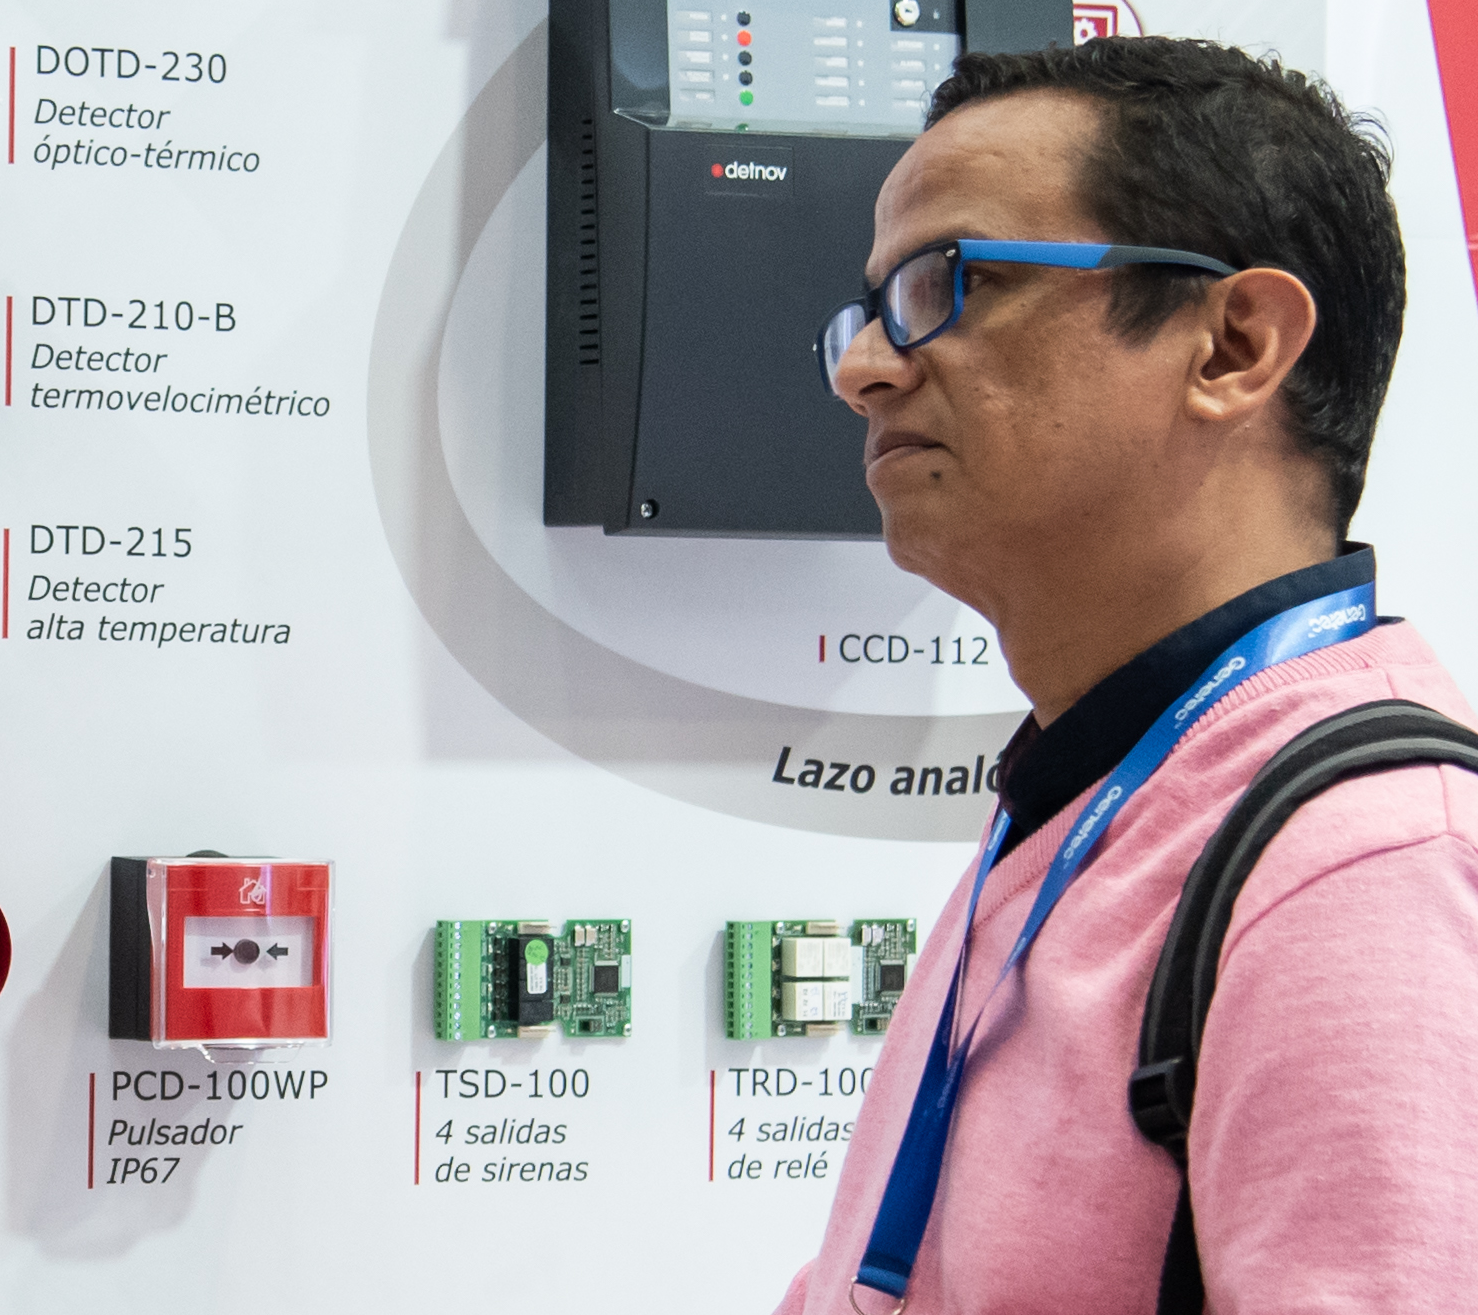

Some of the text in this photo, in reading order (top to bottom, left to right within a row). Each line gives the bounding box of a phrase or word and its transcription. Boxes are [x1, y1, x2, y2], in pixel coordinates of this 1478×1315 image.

[36, 44, 228, 85] DOTD-230
[33, 97, 172, 130] Detector
[33, 133, 261, 173] óptico-térmico
[724, 161, 787, 181] detnov
[31, 295, 237, 333] DTD-210-B
[30, 342, 168, 374] Detector
[30, 382, 331, 418] termovelocimétrico
[30, 523, 192, 559] DTD-215
[27, 574, 165, 604] Detector
[26, 612, 292, 649] alta temperatura
[838, 632, 988, 665] CCD-112
[1174, 656, 1246, 722] Genetec
[772, 745, 876, 794] Lazo
[1063, 785, 1123, 860] Genetec
[111, 1069, 329, 1102] PCD-100WP
[435, 1068, 590, 1099] TSD-100
[107, 1116, 243, 1147] Pulsador
[435, 1117, 568, 1146] 4 salidas
[728, 1116, 855, 1142] 4 salidas
[106, 1156, 181, 1185] IP67
[434, 1155, 589, 1184] de sirenas
[728, 1151, 828, 1179] de relé
